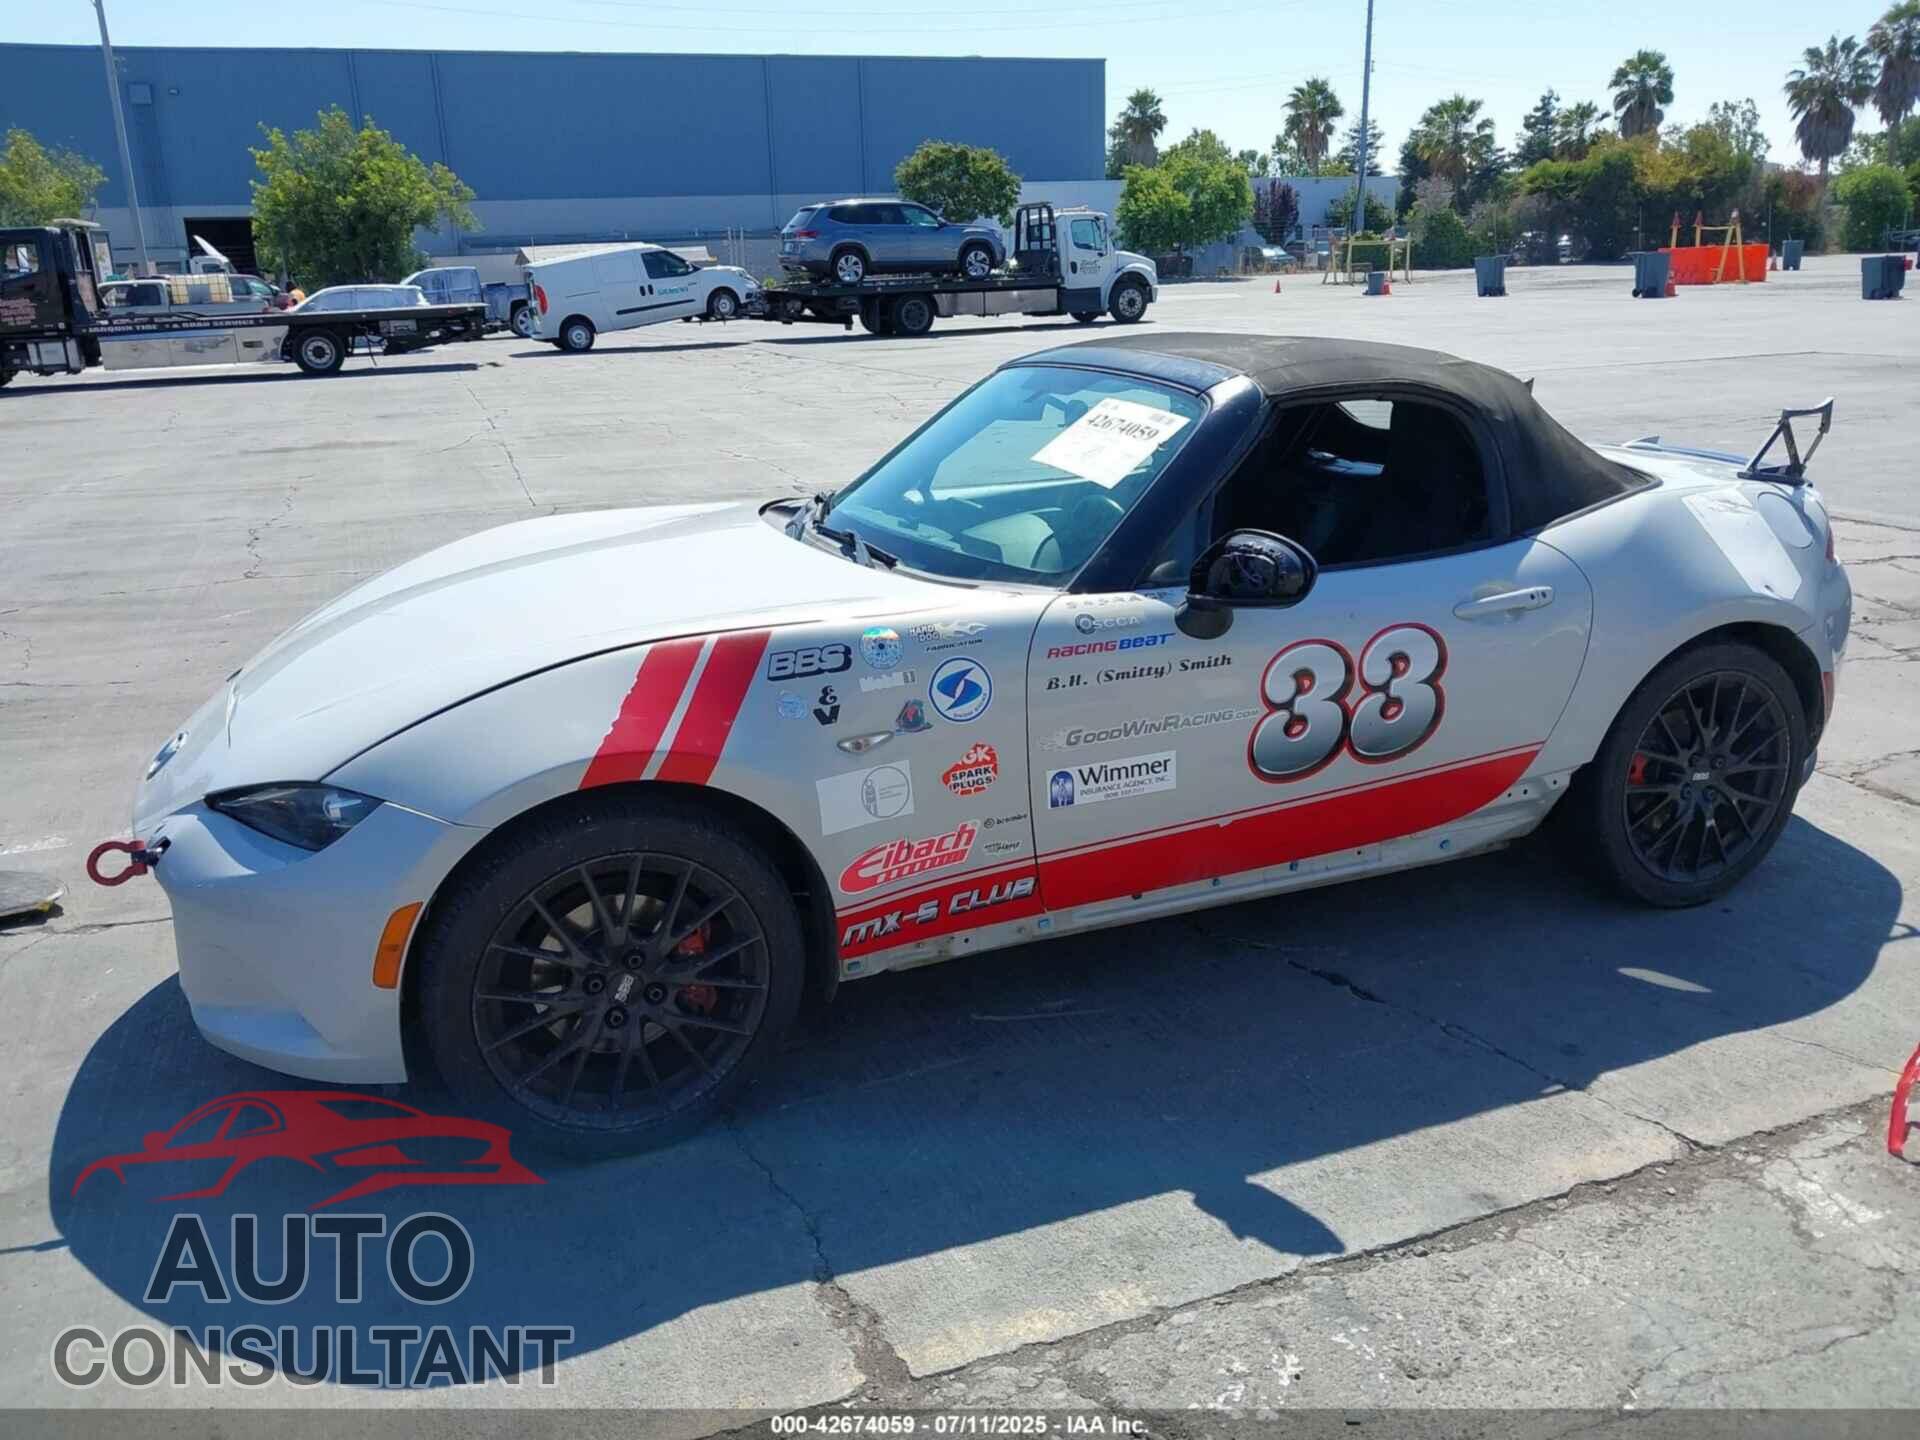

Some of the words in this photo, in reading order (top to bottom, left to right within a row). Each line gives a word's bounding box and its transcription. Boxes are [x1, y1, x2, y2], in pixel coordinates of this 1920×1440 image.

[1087, 413, 1160, 441] 42674059
[767, 643, 852, 681] BBS
[1097, 663, 1173, 686] (Smitty)
[1178, 654, 1232, 672] Smith
[1247, 622, 1449, 784] 33
[952, 766, 992, 781] SPARK
[953, 775, 993, 790] PLUGS
[1078, 758, 1171, 787] Wimmer
[840, 821, 978, 892] Eibach
[949, 877, 1037, 914] CLUB
